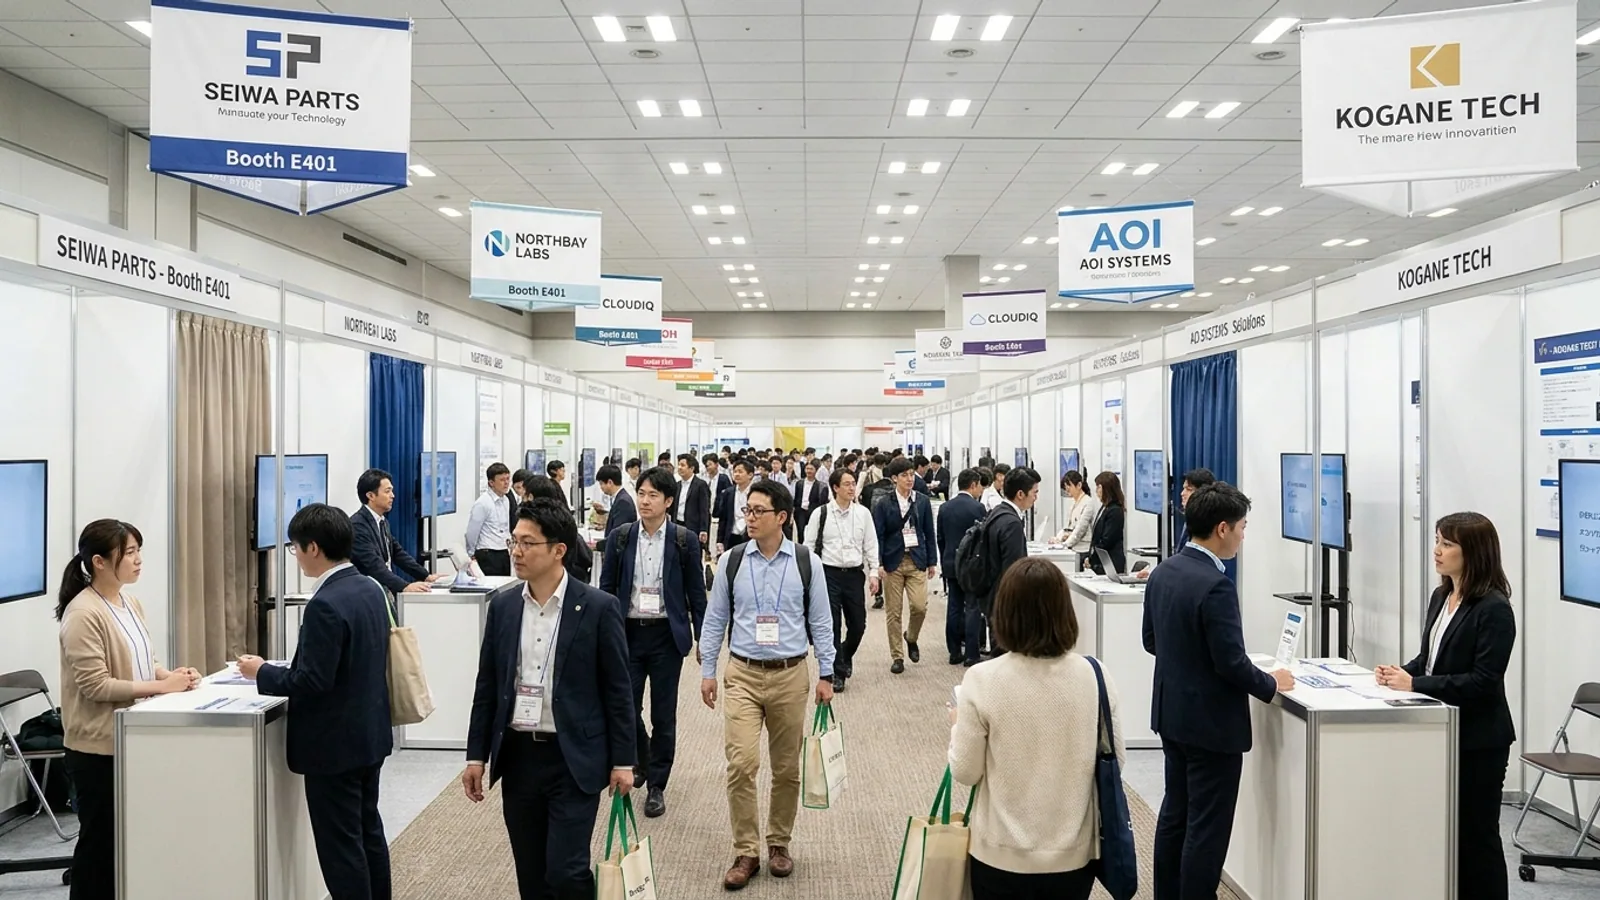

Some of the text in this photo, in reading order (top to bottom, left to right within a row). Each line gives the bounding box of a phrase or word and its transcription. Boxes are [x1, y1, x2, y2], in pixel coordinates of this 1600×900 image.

[204, 82, 360, 112] SEIWA PARTS
[267, 112, 289, 121] your
[1336, 92, 1540, 130] KOGANE TECH
[1357, 134, 1379, 144] The
[226, 149, 337, 172] Booth E401
[515, 232, 588, 249] NORTHBAY
[1088, 218, 1161, 253] AOI
[515, 248, 550, 260] LABS
[1080, 254, 1171, 271] AOI SYSTEMS
[57, 234, 107, 269] SEIWA
[112, 250, 156, 280] PARTS
[168, 265, 202, 293] Booth
[205, 277, 231, 300] E401
[1398, 245, 1492, 291] KOGANE TECH
[508, 285, 566, 298] Booth E401
[602, 298, 654, 311] CLOUDIQ
[988, 312, 1039, 325] CLOUDIQ
